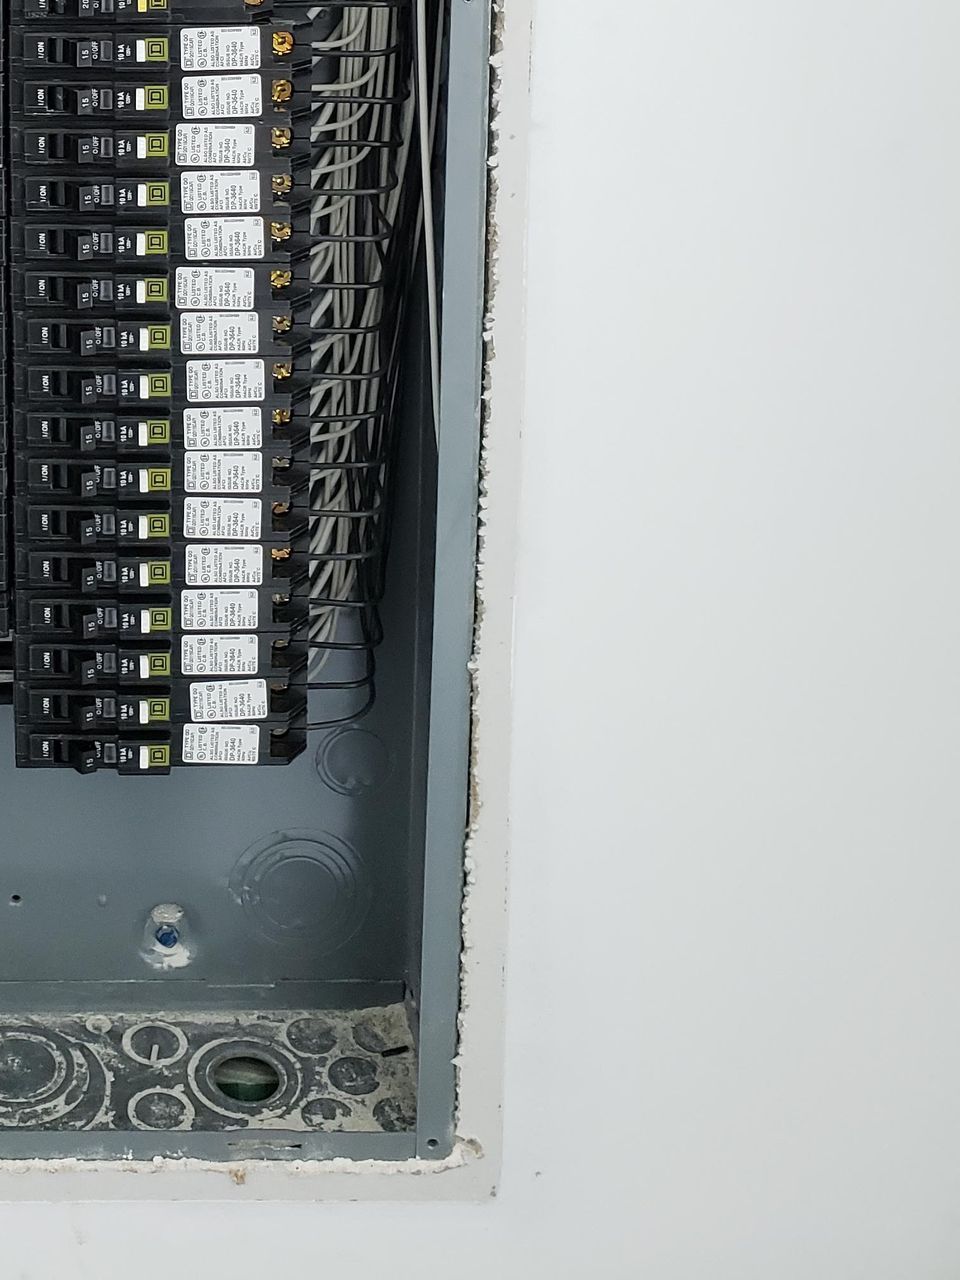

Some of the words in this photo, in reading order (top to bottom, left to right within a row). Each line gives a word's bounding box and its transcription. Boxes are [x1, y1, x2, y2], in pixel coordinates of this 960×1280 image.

[82, 0, 89, 9] 20
[82, 49, 89, 59] 15
[82, 98, 89, 107] 15
[82, 145, 89, 154] 15
[84, 195, 91, 204] 15
[83, 244, 90, 254] 15
[82, 292, 89, 302] 15
[86, 340, 93, 349] 15
[86, 386, 92, 395] 15
[86, 434, 93, 444] 15
[86, 480, 93, 490] 15
[86, 527, 93, 536] 15
[87, 576, 94, 585] 15
[88, 622, 95, 632] 15
[88, 669, 94, 678] 15
[87, 712, 93, 721] 15
[87, 758, 93, 767] 15
